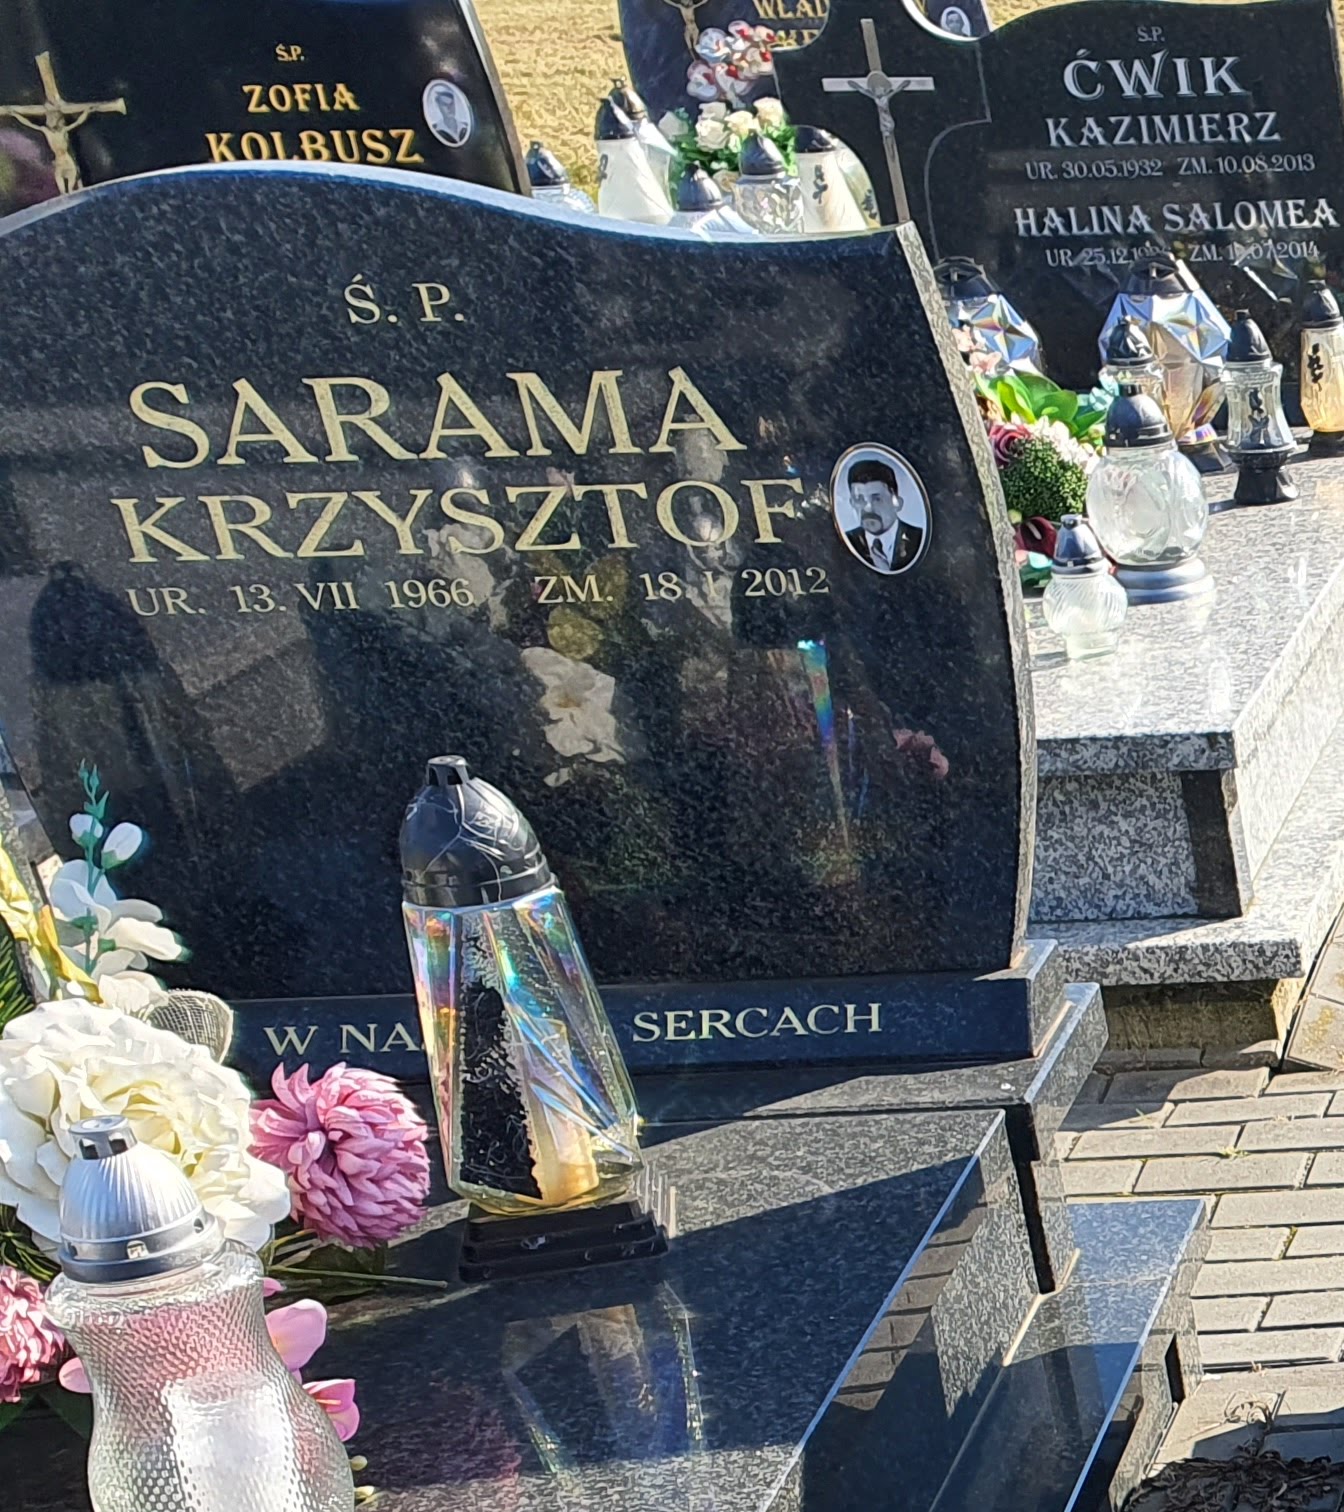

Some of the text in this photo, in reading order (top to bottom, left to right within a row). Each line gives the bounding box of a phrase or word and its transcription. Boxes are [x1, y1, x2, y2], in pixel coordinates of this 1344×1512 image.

[1062, 49, 1248, 101] ĆWIK
[242, 83, 360, 113] ZOFIA
[205, 129, 424, 163] KOLBUSZ
[1047, 111, 1281, 149] KAZIMIERZ
[1025, 160, 1057, 180] UR.
[1062, 158, 1164, 179] 30.05.1932
[1177, 156, 1213, 175] ZM.
[1013, 198, 1341, 238] HALINA SALOMEA
[129, 365, 748, 470] SARAMA
[111, 478, 804, 565] KRZYSZTOF
[127, 590, 206, 617] UR.
[231, 584, 287, 613] 13.
[294, 581, 360, 611] VII
[387, 578, 474, 608] 1966
[533, 575, 614, 605] ZM.
[741, 566, 830, 596] 2012
[263, 1024, 318, 1057] W
[632, 1003, 882, 1042] SERCACH
